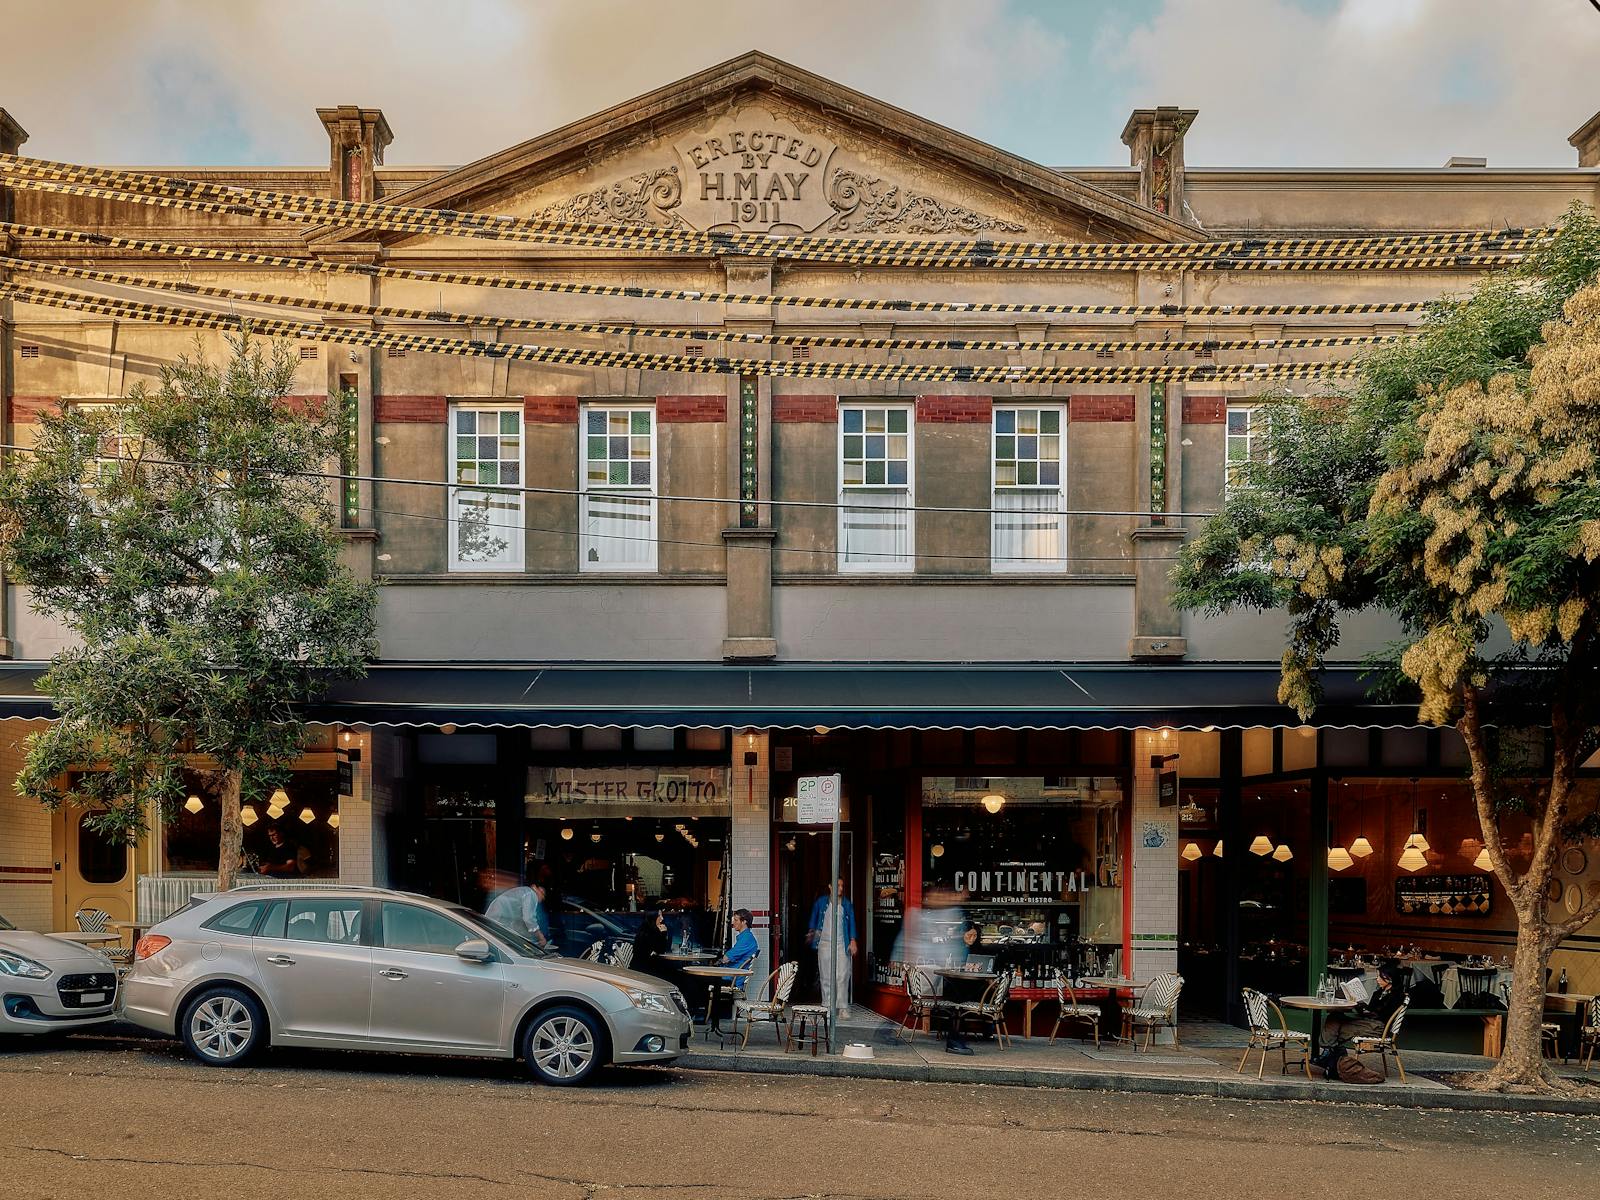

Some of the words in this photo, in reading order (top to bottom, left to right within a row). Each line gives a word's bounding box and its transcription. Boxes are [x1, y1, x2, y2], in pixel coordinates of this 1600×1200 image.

[687, 130, 822, 170] ERECTED
[741, 153, 772, 169] BY
[731, 201, 780, 223] 1911
[544, 781, 628, 804] MISTER
[636, 780, 717, 803] GROTTO
[800, 780, 816, 792] 2P
[954, 871, 1090, 892] CONTINENTAL
